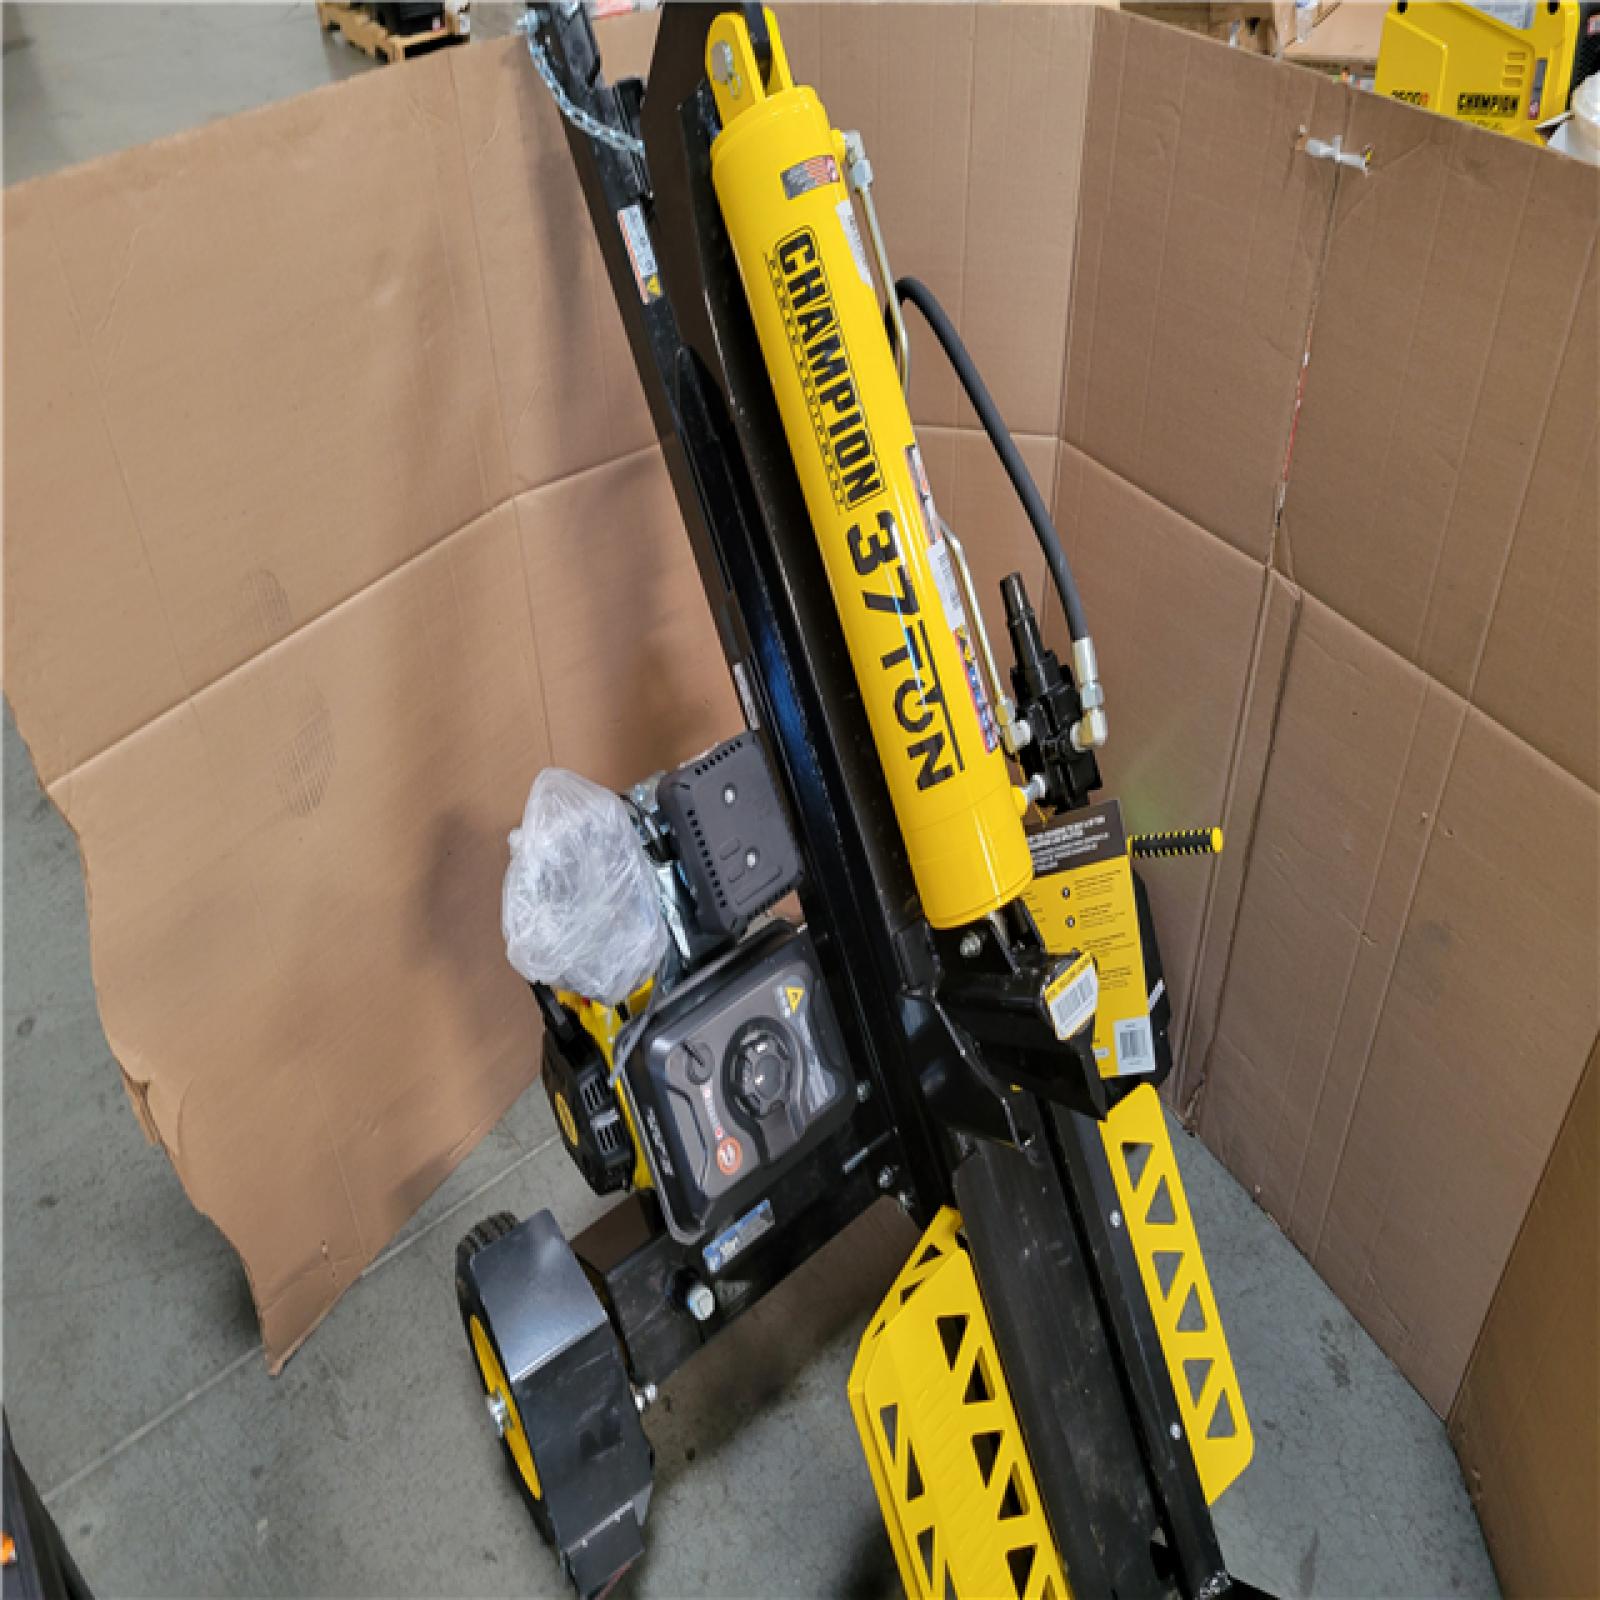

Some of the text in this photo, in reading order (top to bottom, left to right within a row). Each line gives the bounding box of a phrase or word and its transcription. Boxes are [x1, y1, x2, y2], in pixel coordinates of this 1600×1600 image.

[779, 233, 881, 502] CHAMPION
[847, 510, 919, 615] 37
[880, 623, 956, 791] TON
